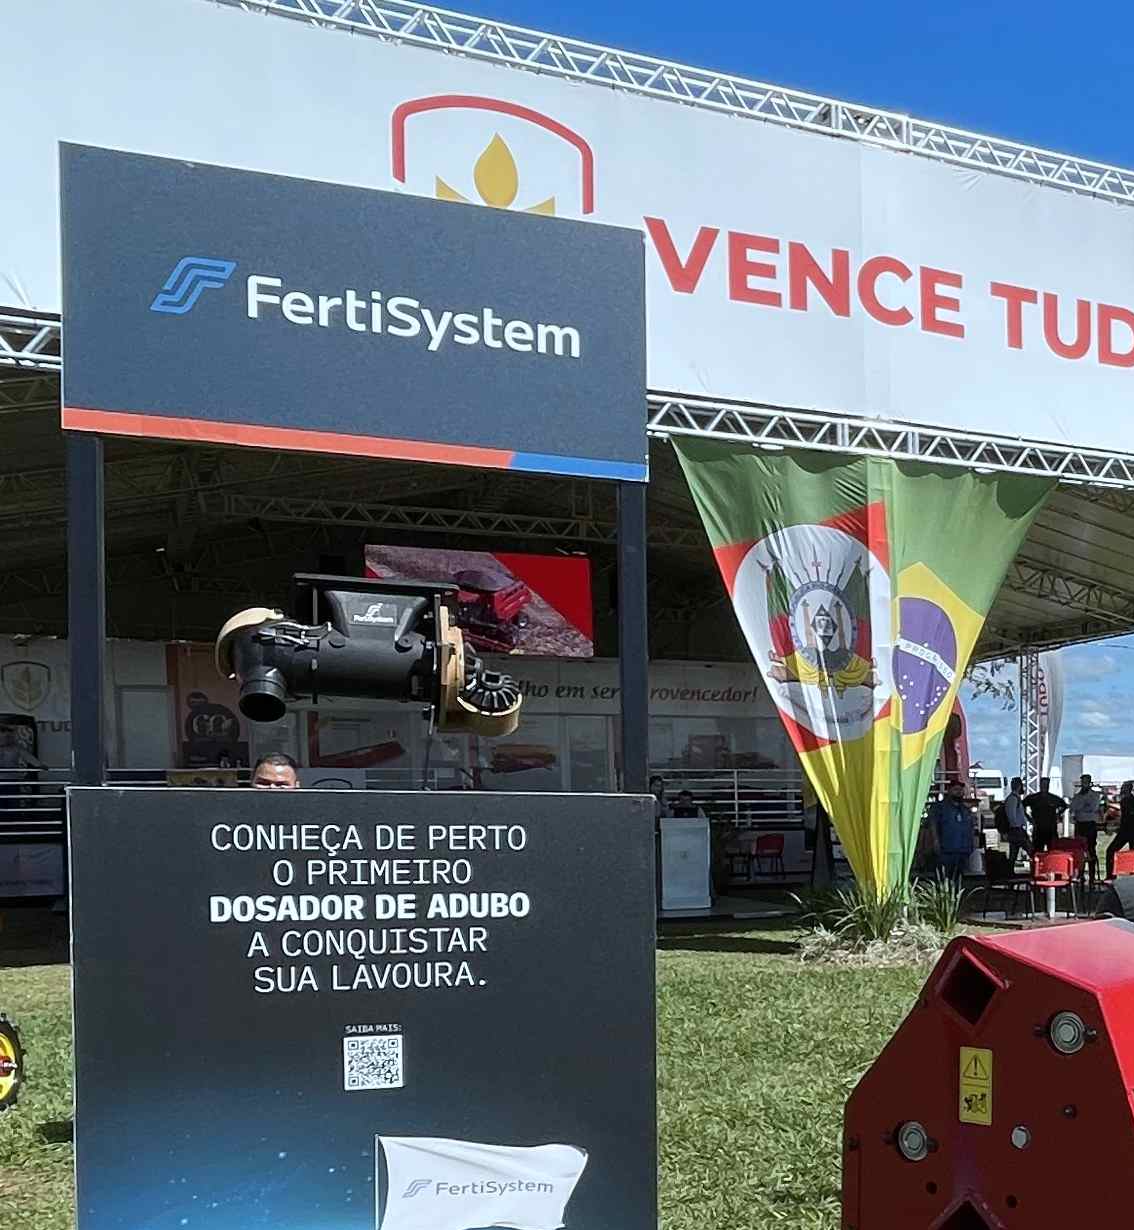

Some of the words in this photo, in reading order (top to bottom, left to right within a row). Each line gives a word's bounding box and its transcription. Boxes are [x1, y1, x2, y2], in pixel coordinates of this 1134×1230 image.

[643, 216, 965, 338] VENCE
[247, 274, 581, 358] FertiSystem
[650, 686, 758, 703] rovencedor!
[211, 824, 363, 856] CONHEÇA
[376, 825, 415, 850] DE
[429, 825, 527, 850] PERTO
[273, 859, 294, 886] O
[307, 859, 472, 885] PRIMEIRO
[209, 894, 364, 922] DOSADOR
[375, 894, 416, 920] DE
[427, 892, 530, 919] ADUBO
[247, 931, 269, 958] A
[282, 927, 488, 959] CONQUISTAR
[254, 965, 319, 993] SUA
[332, 961, 487, 991] LAVOURA.
[345, 1024, 374, 1033] SAIBA
[436, 1179, 554, 1196] FertiSystem
